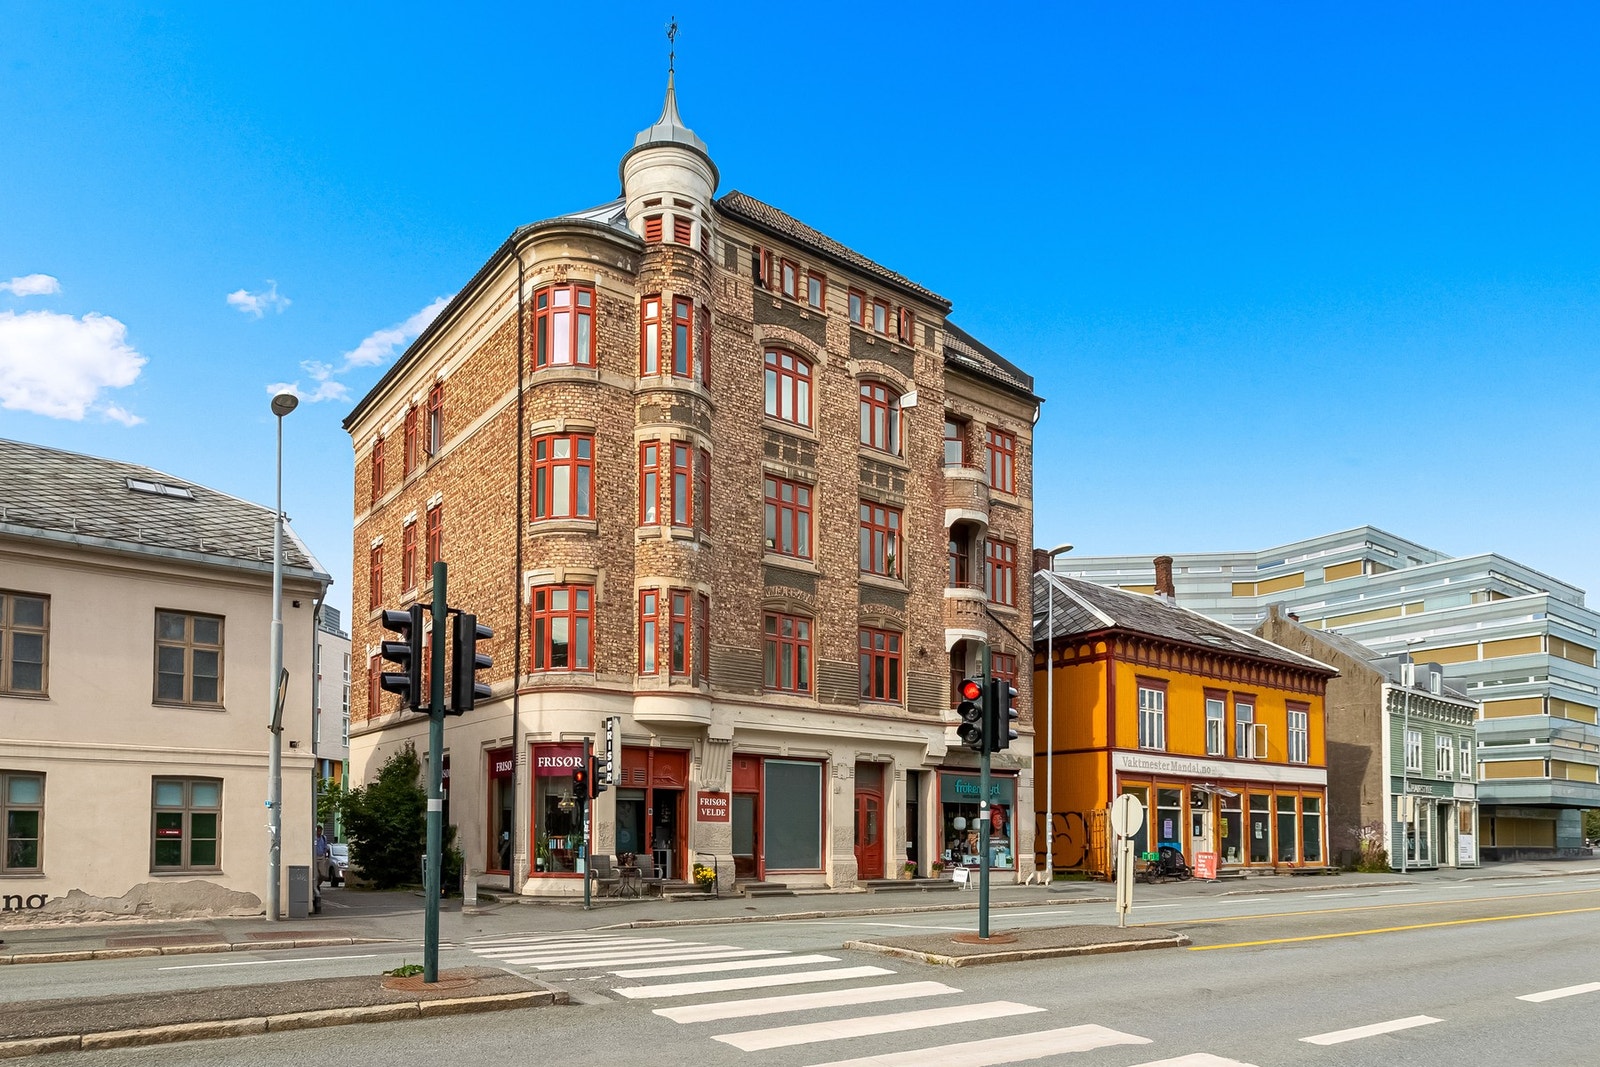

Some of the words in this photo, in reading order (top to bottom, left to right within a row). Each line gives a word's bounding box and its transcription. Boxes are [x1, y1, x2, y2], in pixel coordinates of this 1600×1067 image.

[538, 756, 584, 767] FRISØR
[700, 797, 727, 807] FRISØR
[701, 808, 726, 817] VELDE
